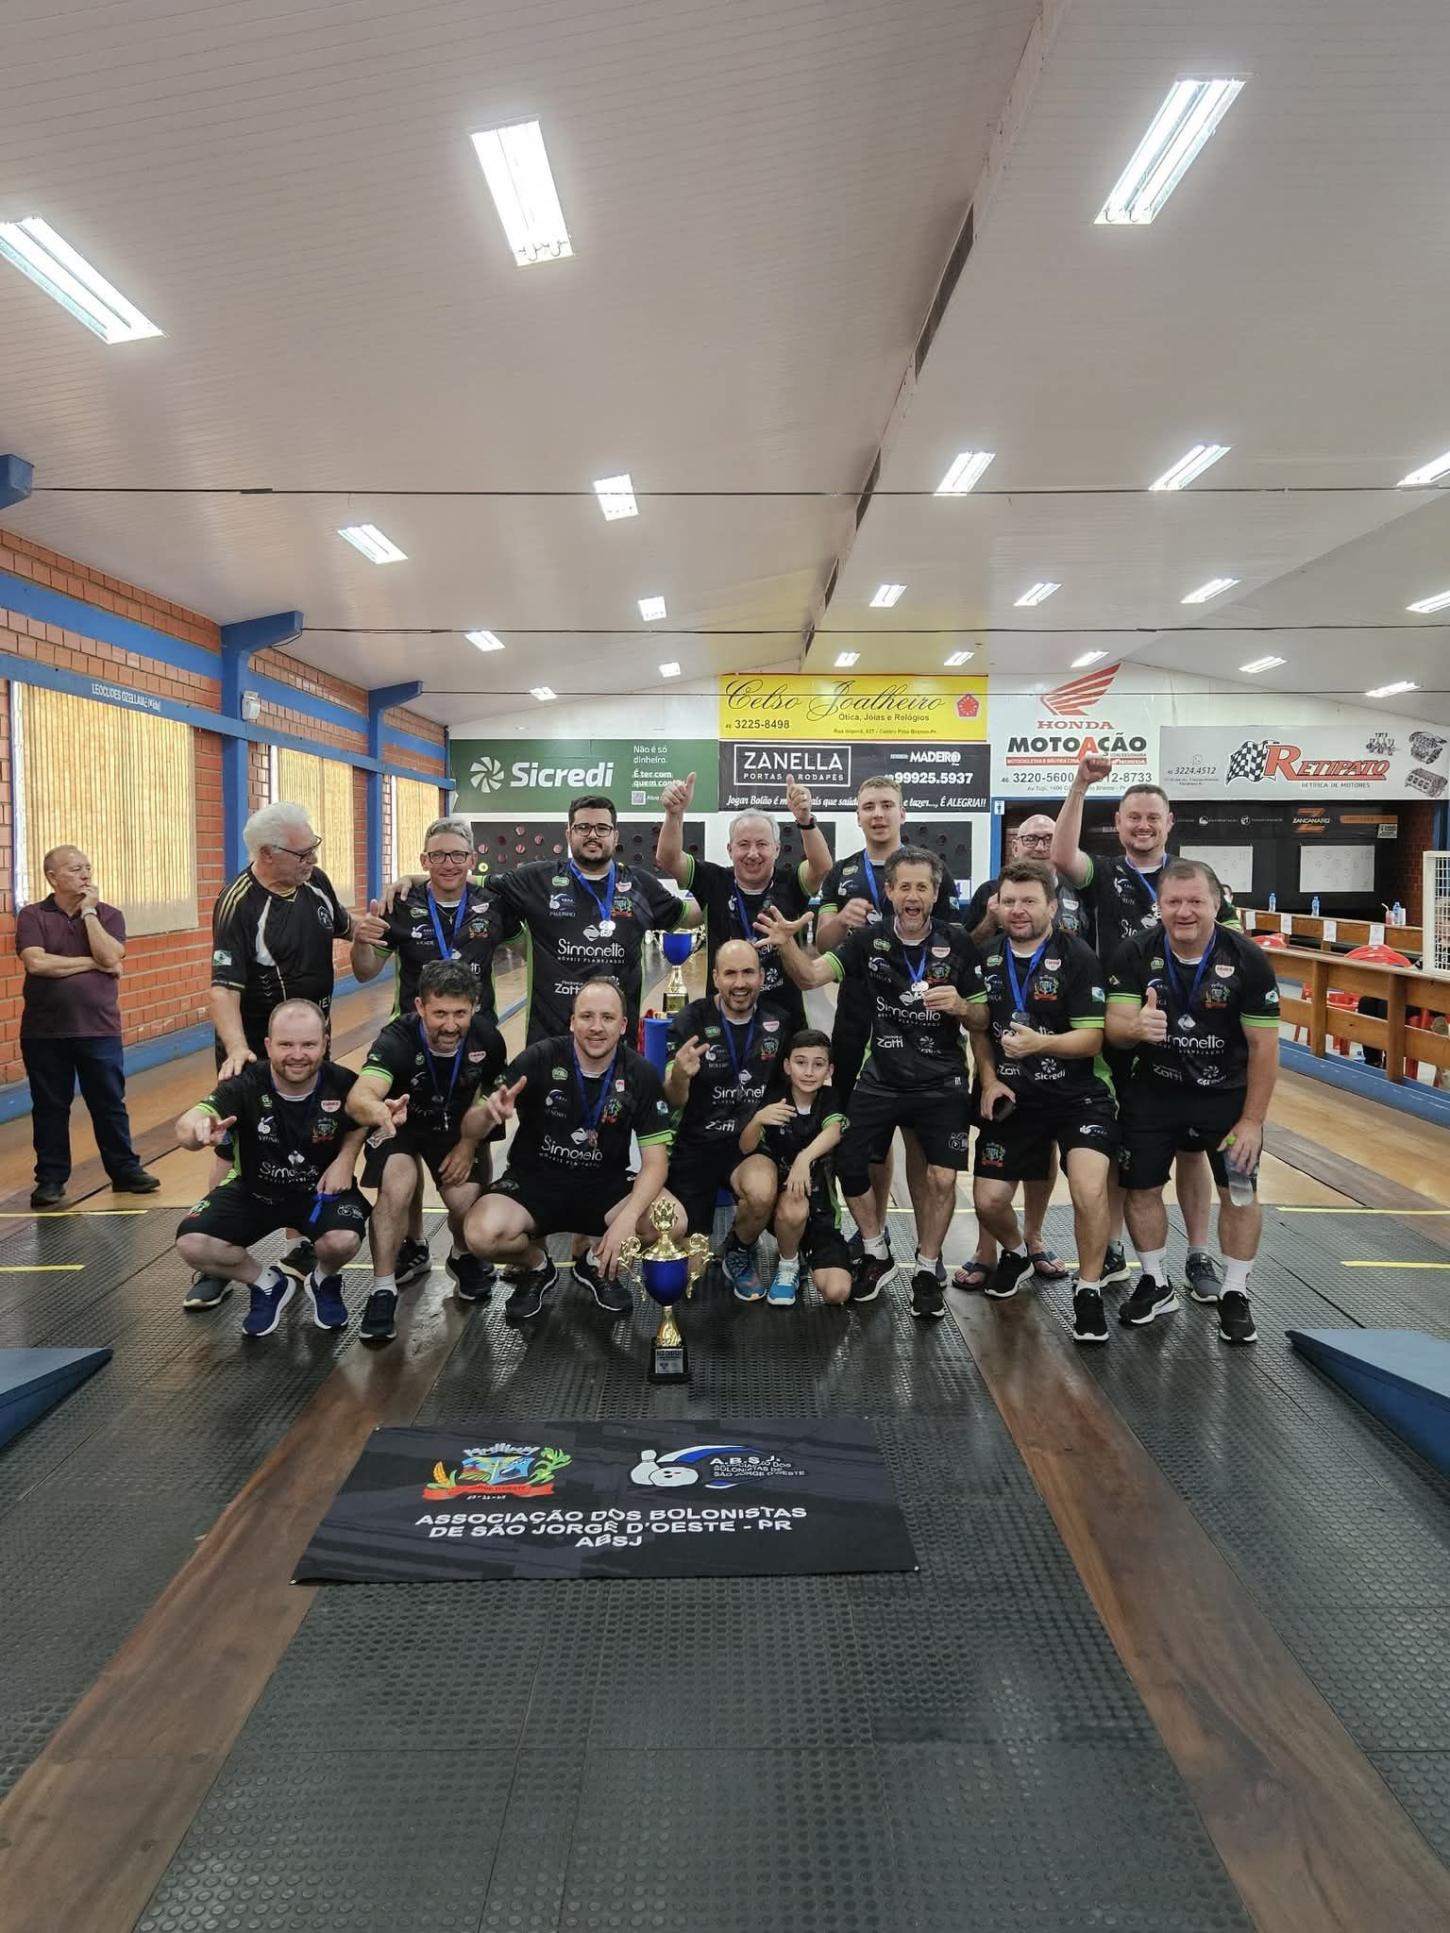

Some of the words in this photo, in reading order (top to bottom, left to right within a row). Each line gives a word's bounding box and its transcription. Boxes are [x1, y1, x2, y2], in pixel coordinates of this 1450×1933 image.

[725, 680, 801, 710] Celso
[806, 680, 945, 721] Joalheiro
[734, 719, 790, 729] 3225-8498
[894, 713, 930, 723] Relógios
[1037, 720, 1115, 730] HONDA
[633, 745, 650, 753] Não
[651, 745, 657, 753] é
[1007, 732, 1147, 757] MOTOAÇÃO
[744, 752, 843, 770] ZANELLA
[510, 762, 614, 787] Sicredi
[1174, 766, 1217, 775] 3224.4512
[797, 773, 844, 781] RODAPÉS
[895, 771, 973, 784] 99925.5937
[1013, 772, 1074, 783] 3220-5600
[750, 795, 772, 805] Bolão
[773, 796, 779, 805] é
[823, 798, 837, 807] que
[940, 795, 946, 807] É
[946, 798, 987, 807] ALEGRIA!!
[557, 938, 625, 957] Simonetto
[1034, 1069, 1066, 1080] Sicredi
[415, 1509, 584, 1525] ASSOCIAÇÃO
[590, 1508, 642, 1521] DOS
[649, 1506, 808, 1520] BOLONISTAS
[428, 1526, 465, 1537] DE
[470, 1523, 526, 1537] SÃO
[531, 1519, 619, 1534] JORGE
[626, 1521, 736, 1534] D'OESTE
[758, 1520, 793, 1531] PR
[574, 1534, 642, 1547] ABSJ
